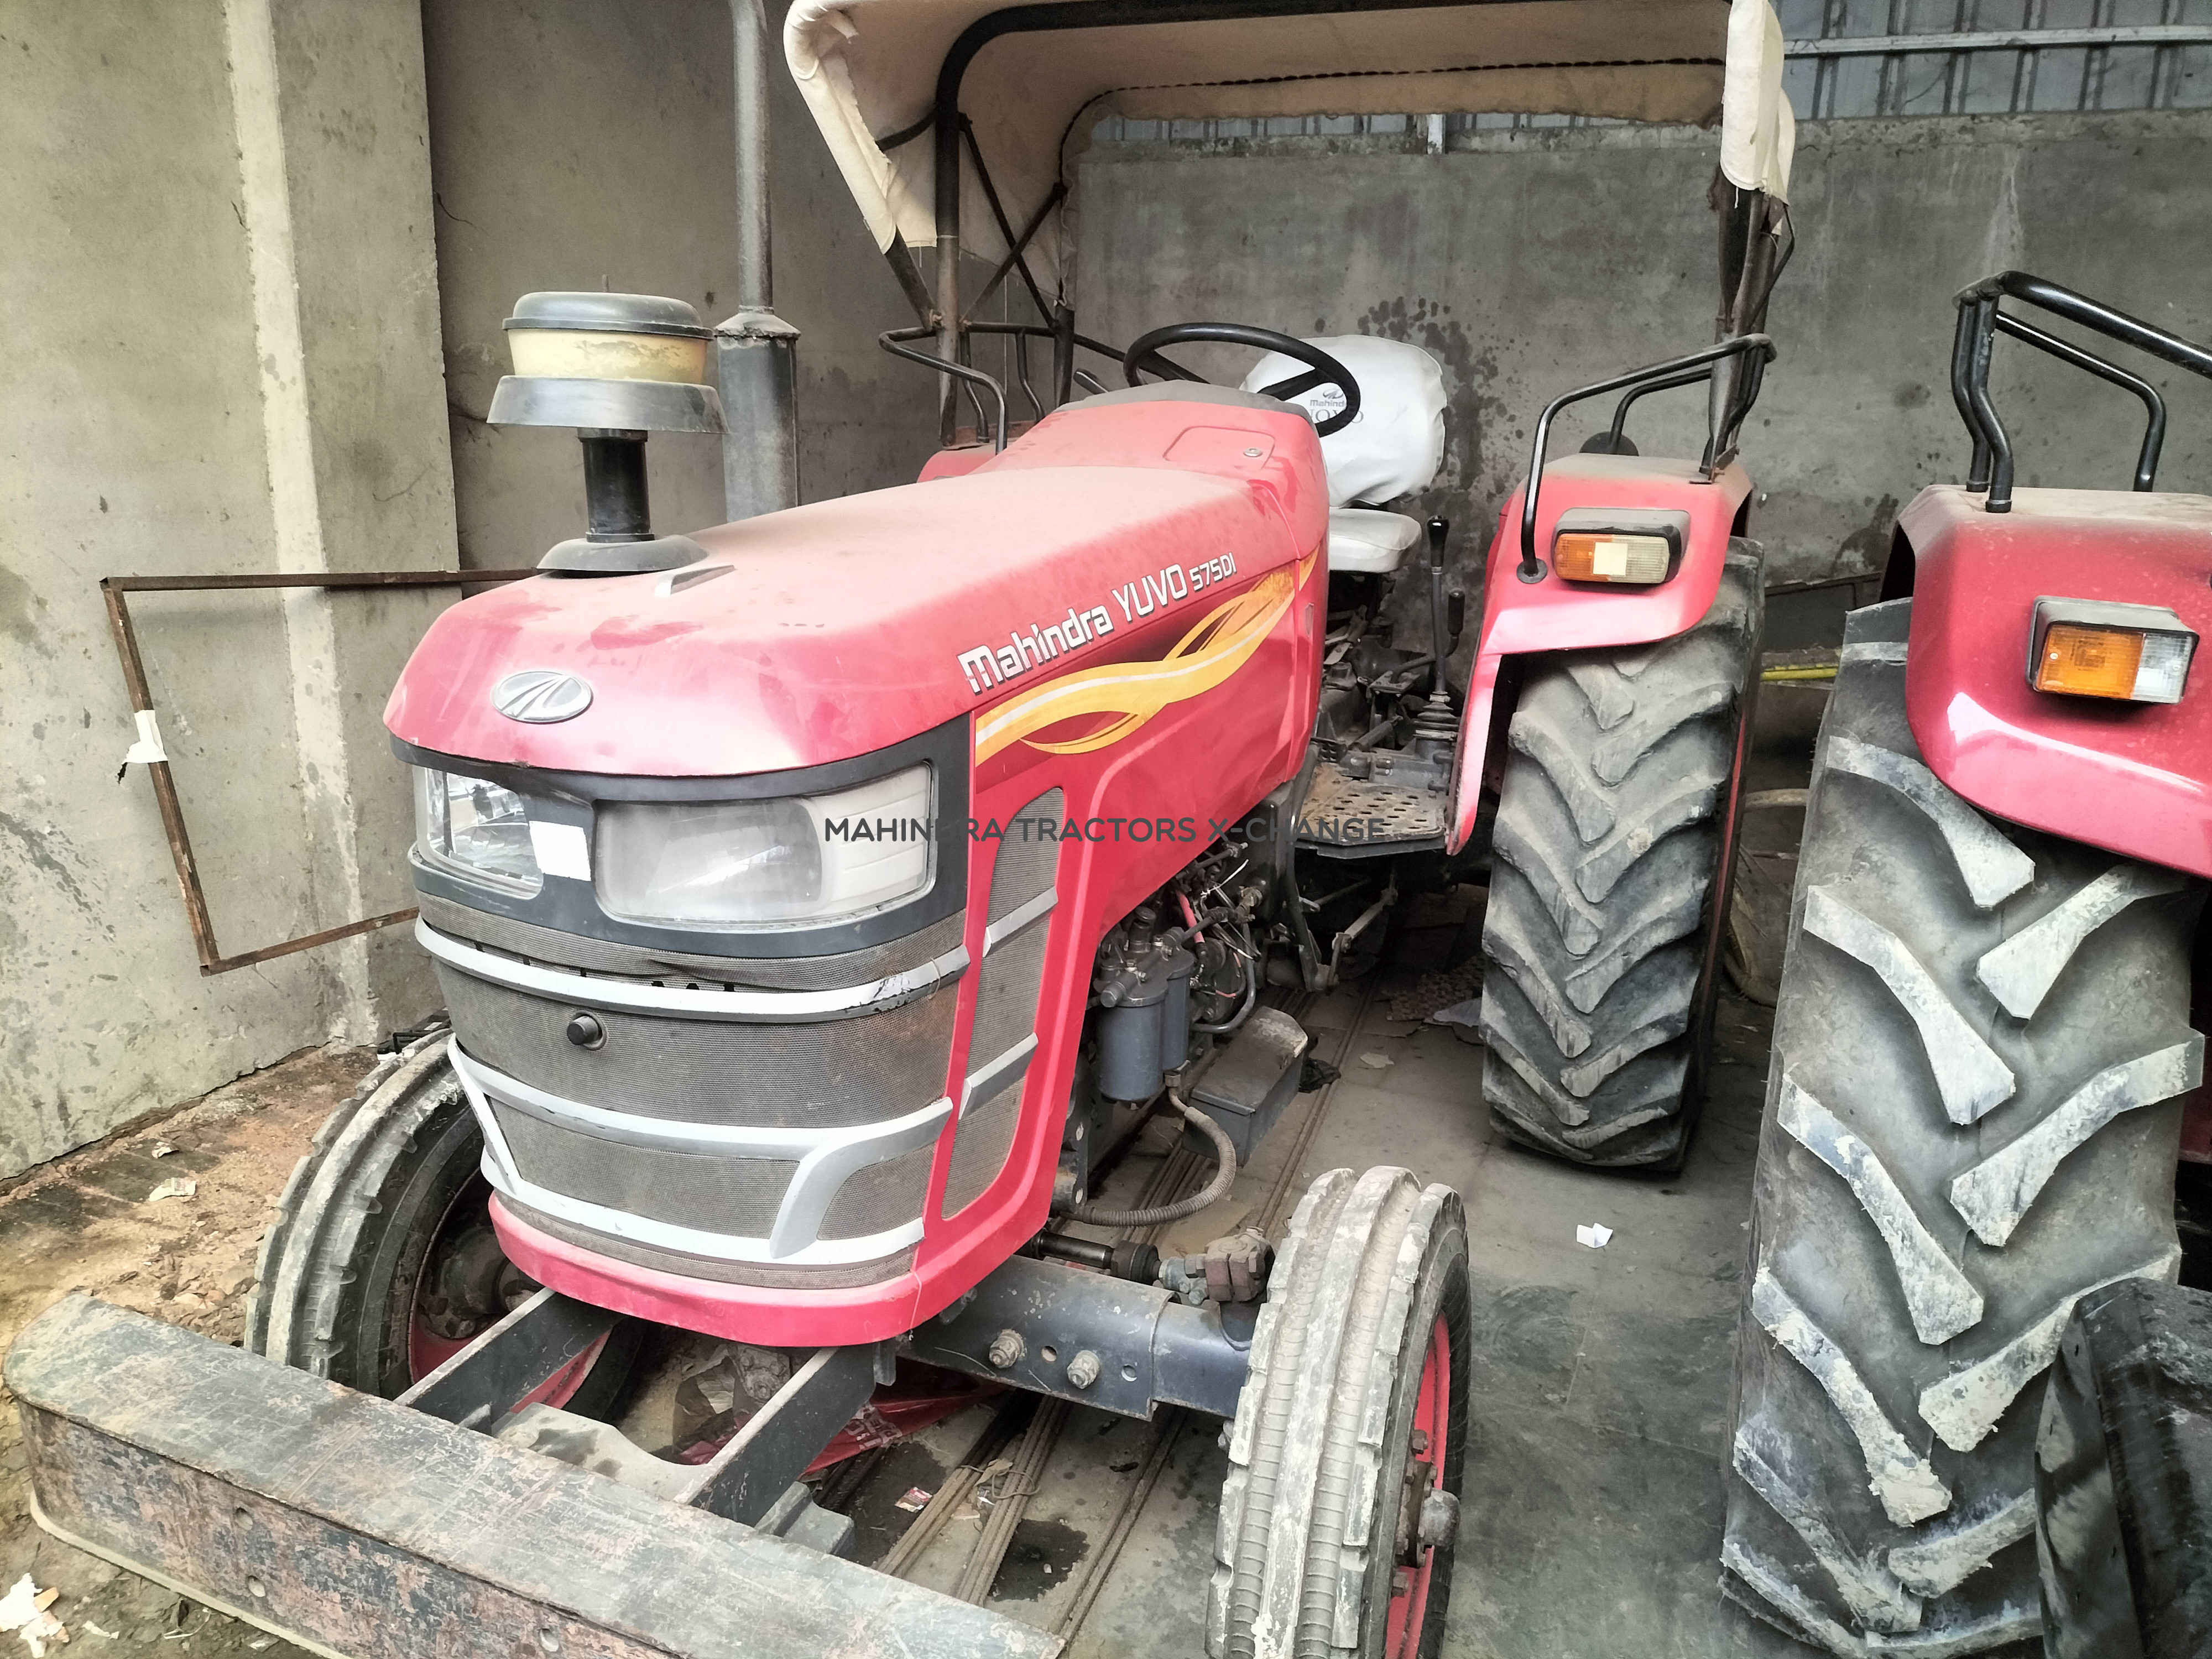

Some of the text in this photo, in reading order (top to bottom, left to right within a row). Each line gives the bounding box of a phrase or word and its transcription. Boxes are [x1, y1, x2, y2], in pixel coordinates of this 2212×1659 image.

[957, 552, 1237, 694] Mahindra YUVO 575DI
